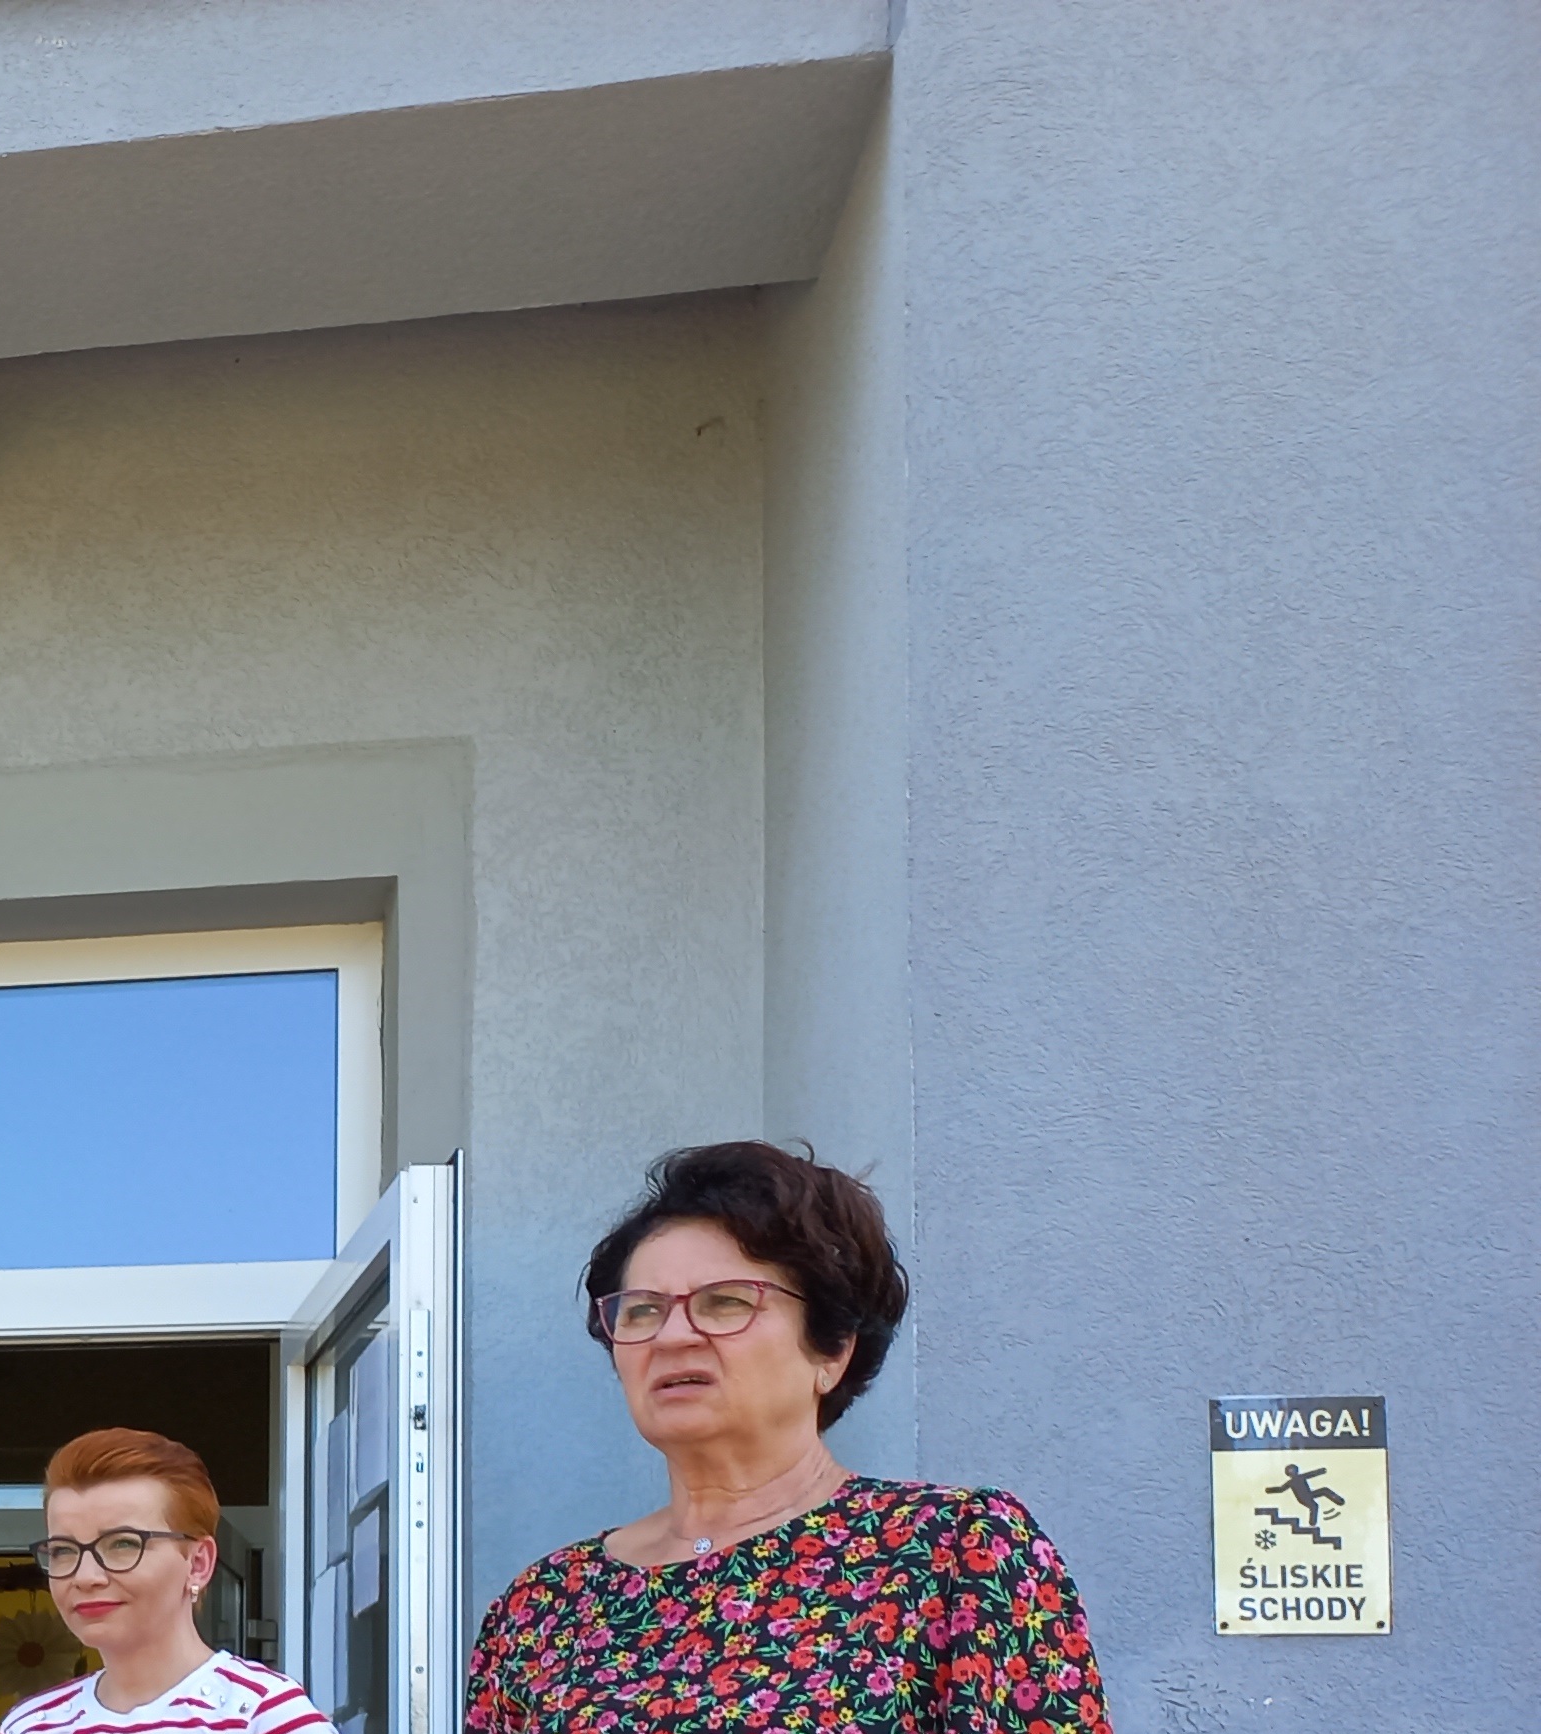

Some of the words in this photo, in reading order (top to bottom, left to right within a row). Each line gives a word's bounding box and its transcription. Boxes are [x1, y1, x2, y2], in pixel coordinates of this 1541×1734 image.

[1225, 1408, 1370, 1439] UWAGA!
[1239, 1557, 1364, 1589] ŚLISKIE
[1238, 1596, 1367, 1621] SCHODY
